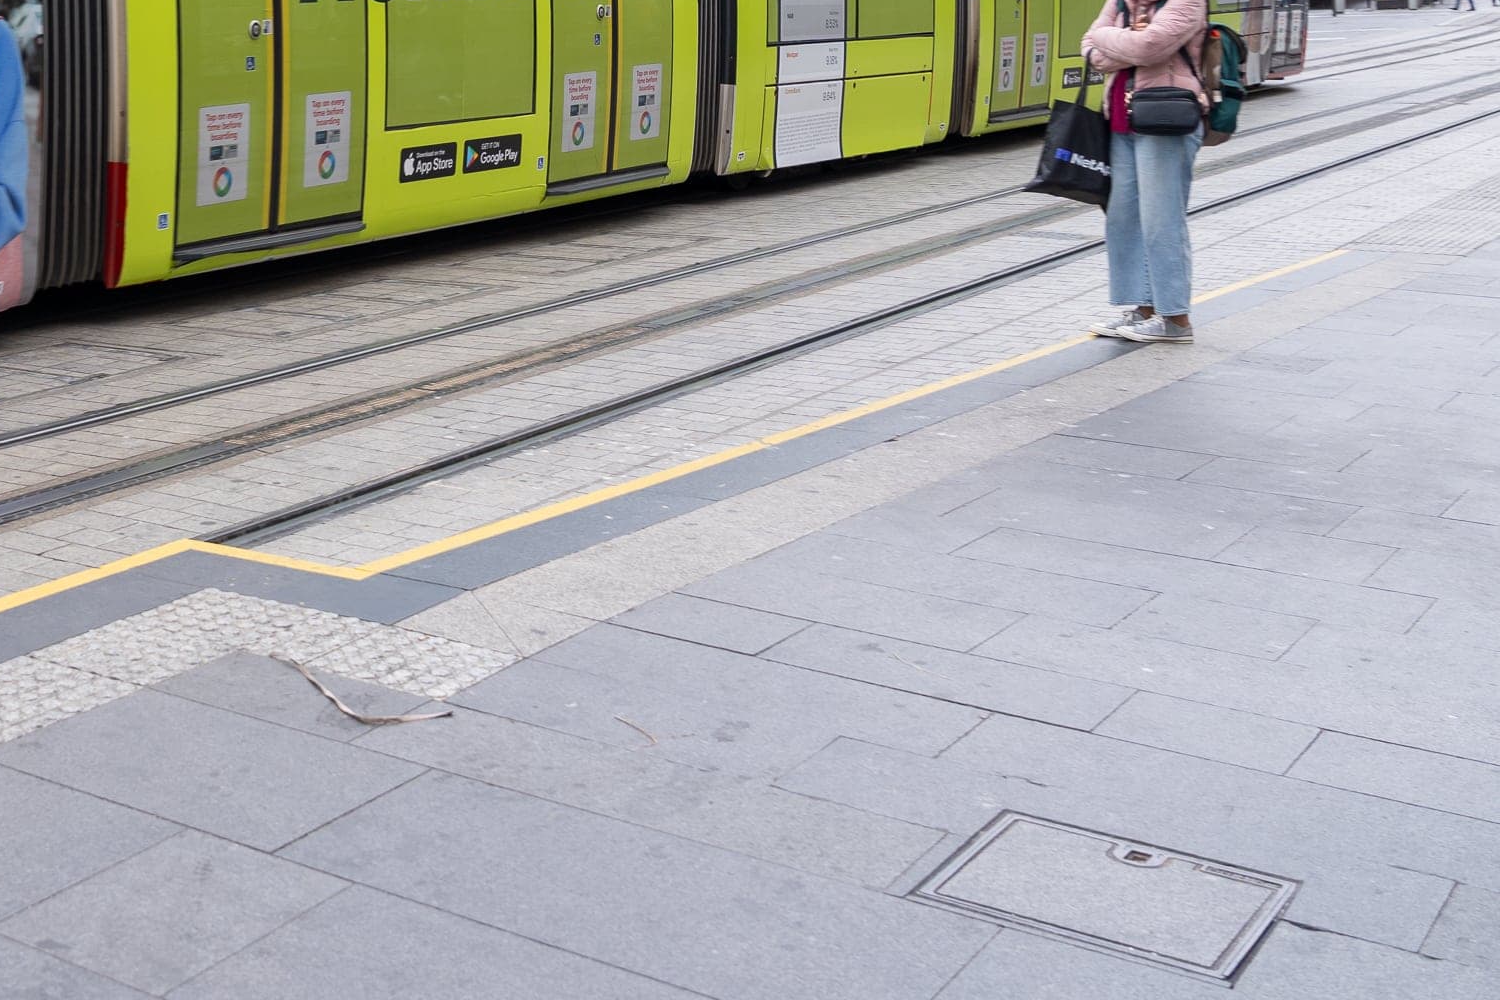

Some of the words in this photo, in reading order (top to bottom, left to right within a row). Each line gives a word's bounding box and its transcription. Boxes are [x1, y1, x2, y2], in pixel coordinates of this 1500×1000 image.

[480, 149, 504, 165] Google
[505, 148, 518, 163] Play
[415, 160, 432, 175] App
[433, 157, 454, 170] Store
